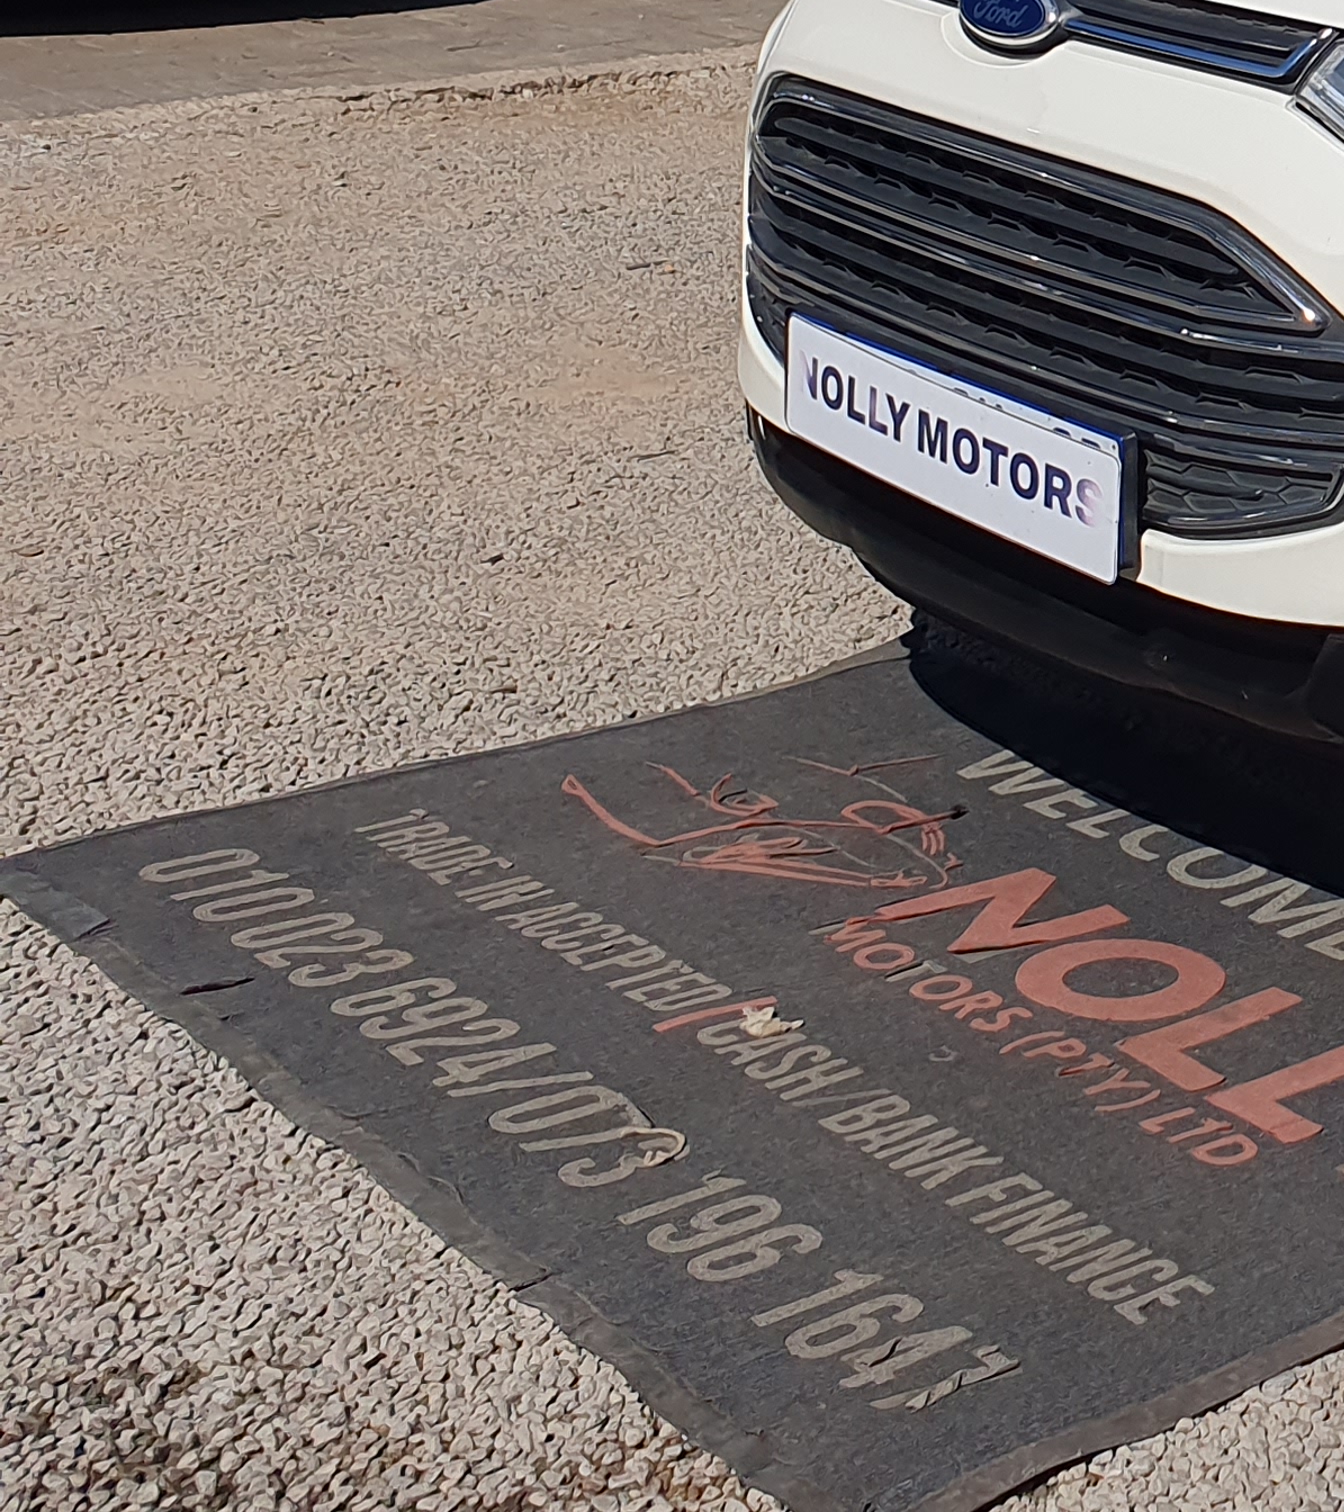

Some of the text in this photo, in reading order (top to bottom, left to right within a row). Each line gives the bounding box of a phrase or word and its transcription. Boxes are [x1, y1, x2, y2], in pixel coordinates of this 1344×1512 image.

[917, 408, 1103, 528] MOTORS
[354, 808, 515, 885] TRADE
[455, 875, 555, 911] IN
[945, 1172, 1216, 1325] FINANCE
[812, 916, 1259, 1166] MOTORS (PTY) LTD
[616, 1170, 822, 1282] 196
